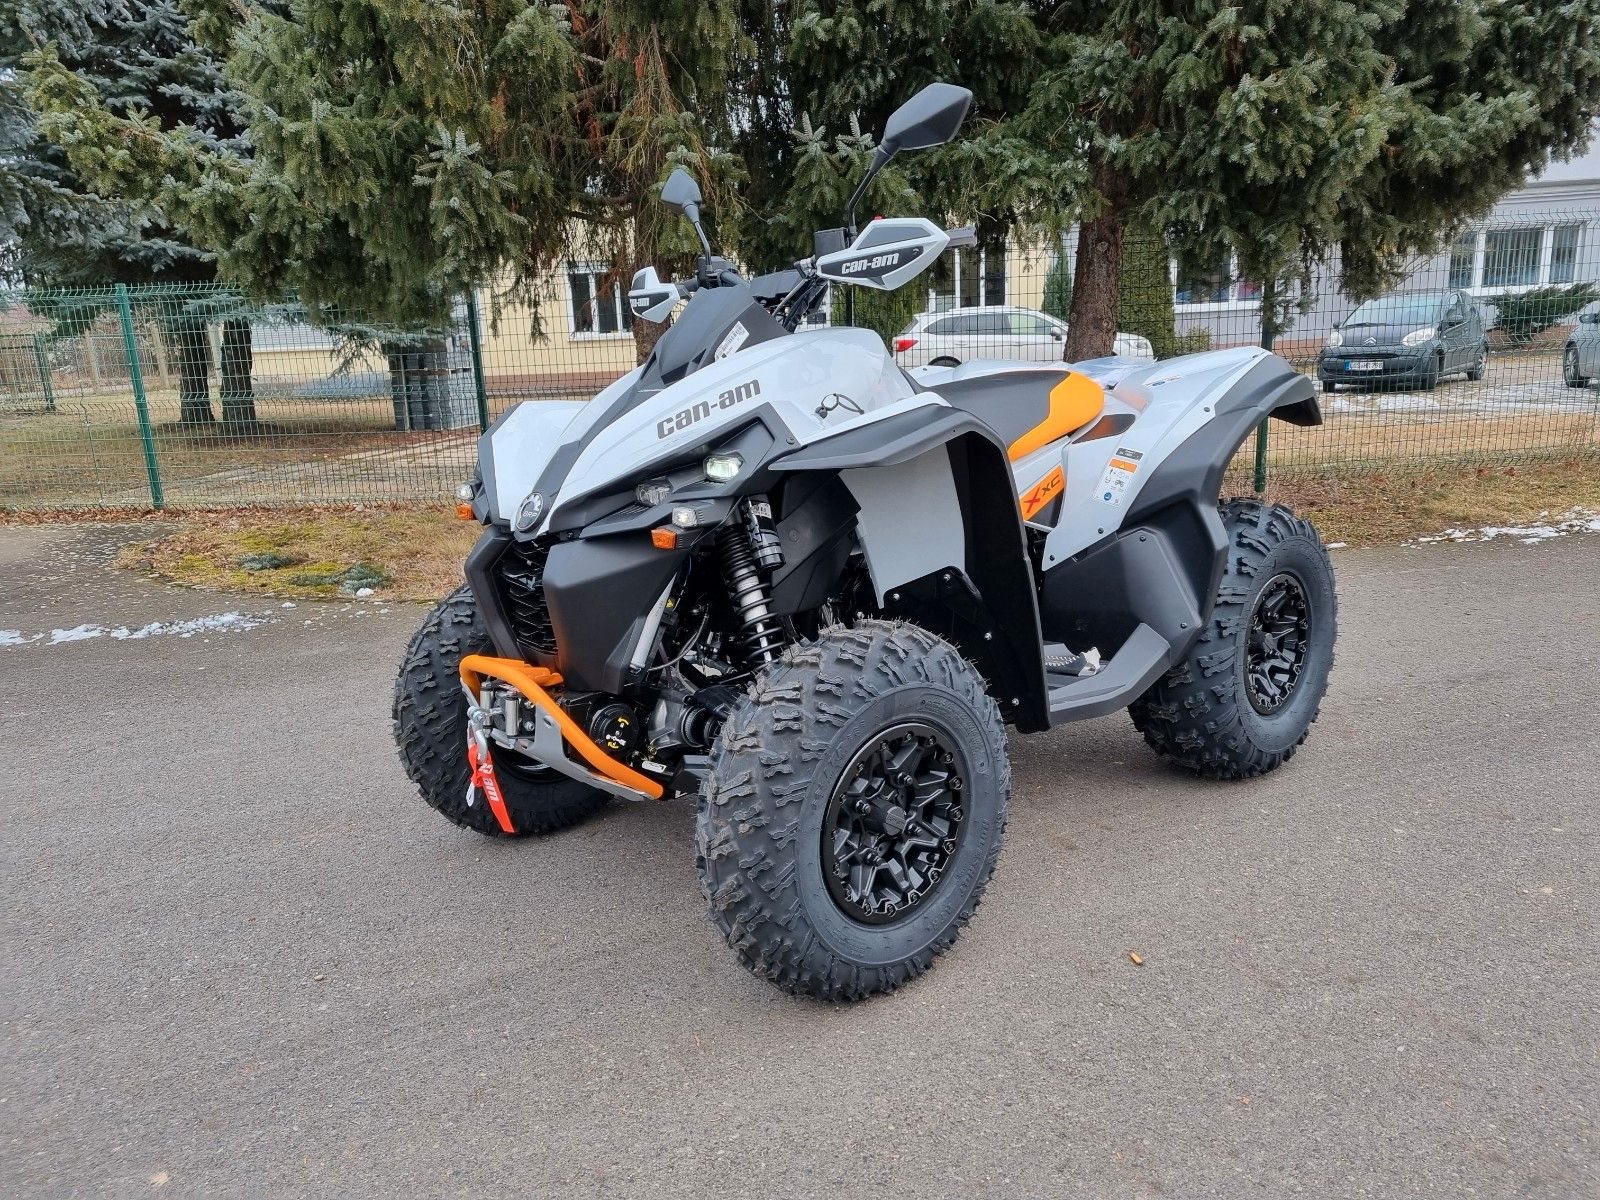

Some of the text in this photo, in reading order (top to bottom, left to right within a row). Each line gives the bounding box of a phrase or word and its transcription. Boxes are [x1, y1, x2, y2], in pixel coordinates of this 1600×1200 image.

[842, 253, 899, 274] can-am
[657, 379, 761, 439] can-am
[1024, 486, 1041, 513] X
